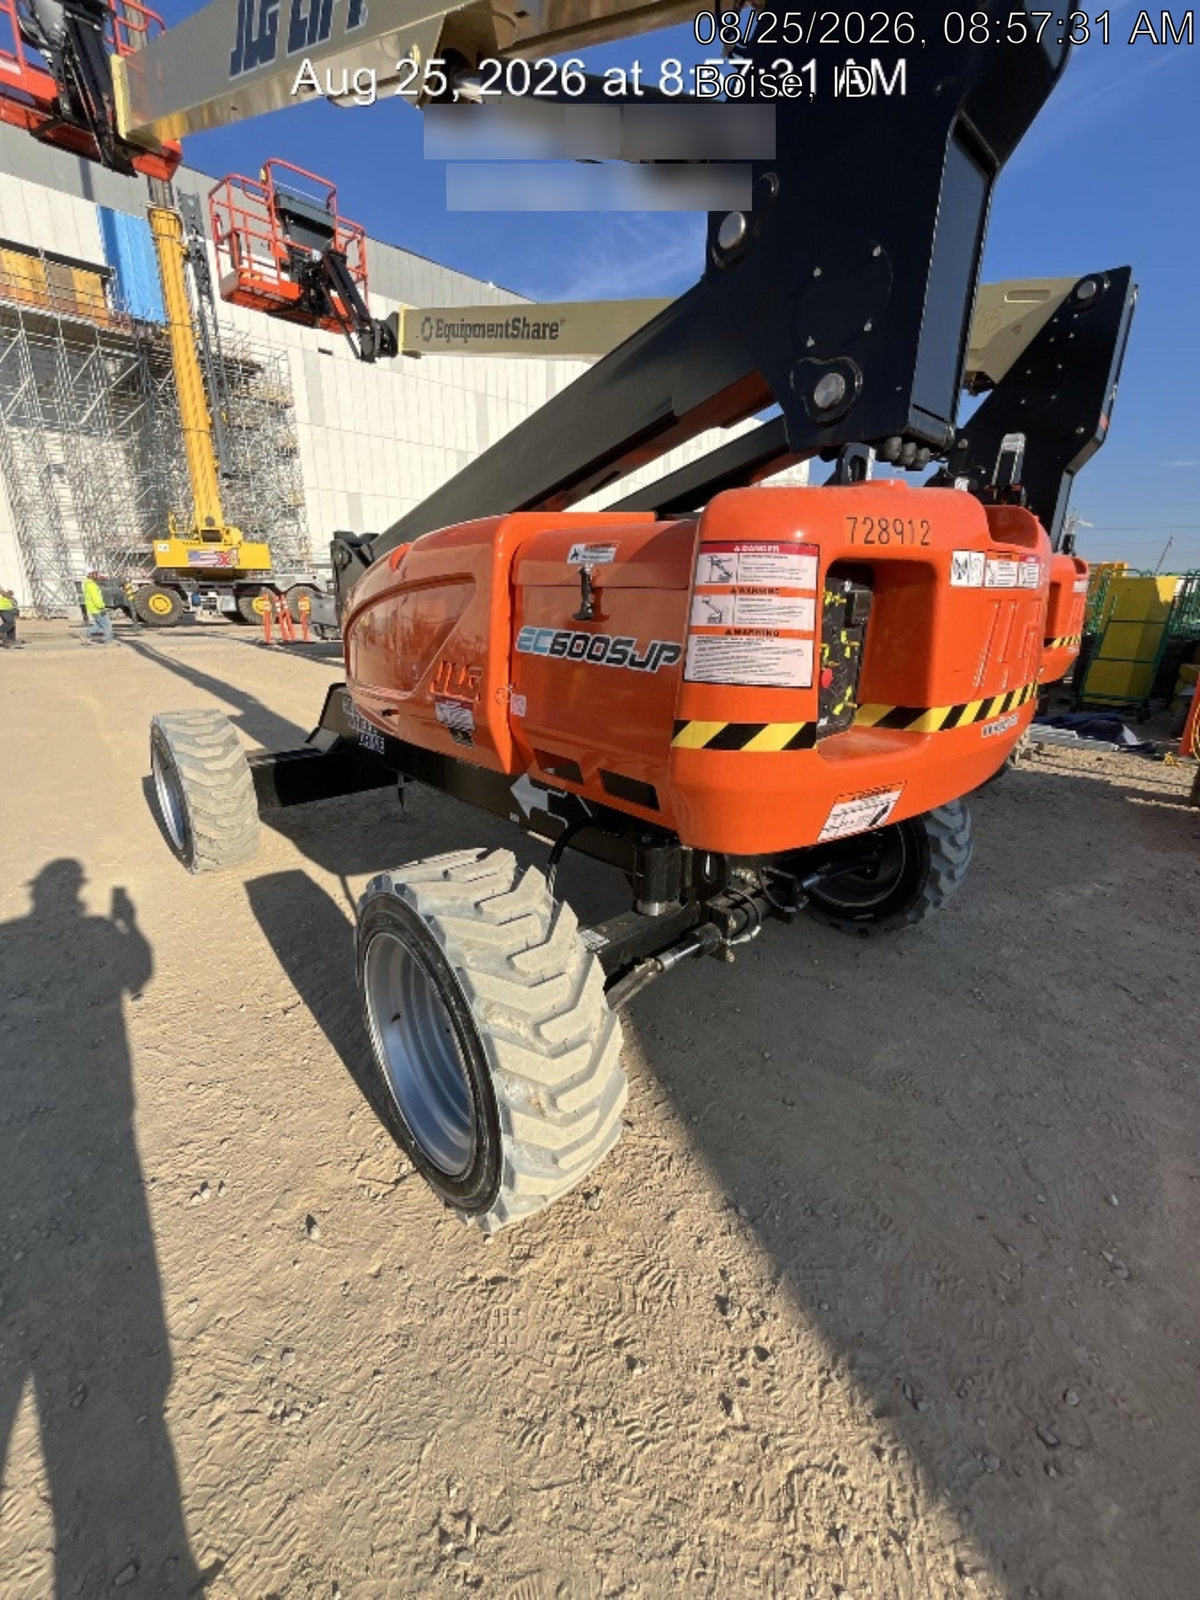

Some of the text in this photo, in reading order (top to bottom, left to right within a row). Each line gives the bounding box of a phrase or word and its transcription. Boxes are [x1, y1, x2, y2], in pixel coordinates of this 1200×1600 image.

[434, 316, 560, 343] EquipmentShare
[846, 516, 931, 546] 728912
[733, 627, 780, 637] WARNING
[515, 625, 683, 673] EC600SJP
